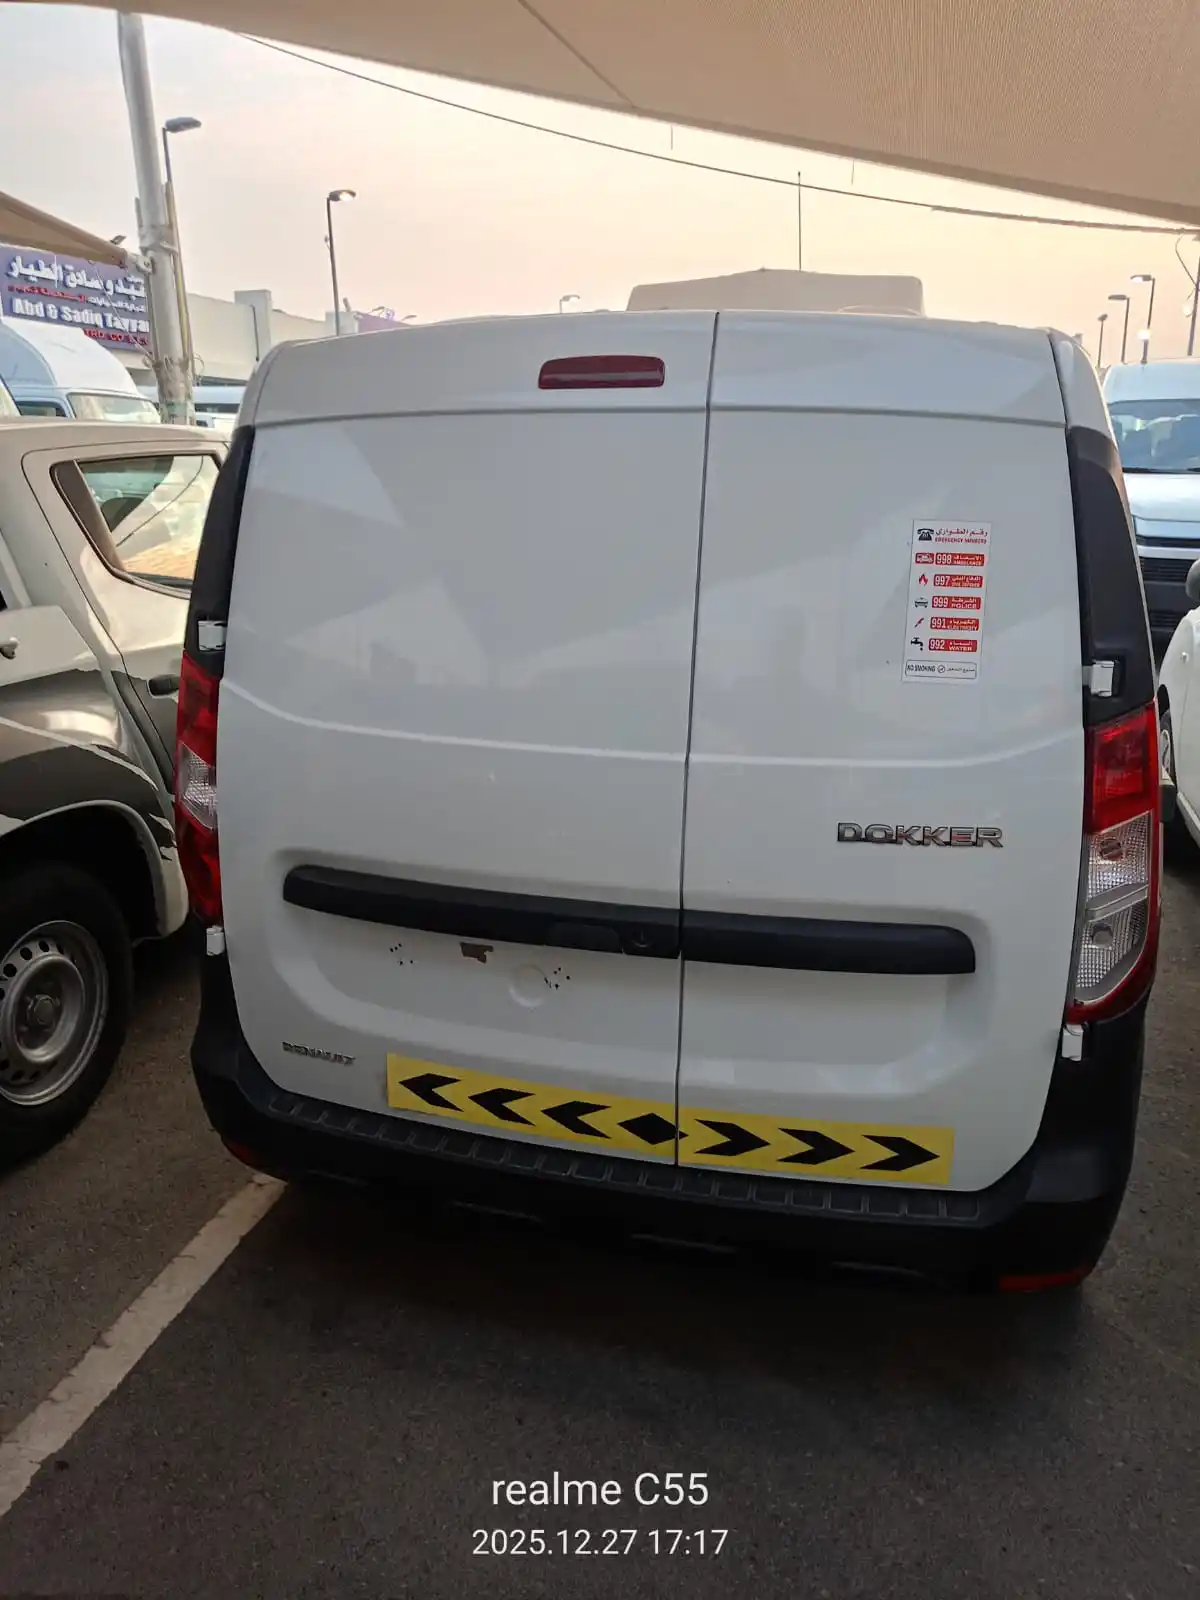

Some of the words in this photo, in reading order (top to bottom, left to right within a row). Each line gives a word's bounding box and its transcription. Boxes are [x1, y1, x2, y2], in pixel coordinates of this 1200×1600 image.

[12, 298, 45, 317] Abd
[60, 306, 104, 328] Sadiq
[936, 553, 952, 564] 998
[935, 575, 950, 586] 997
[932, 596, 949, 607] 999
[931, 618, 947, 629] 991
[929, 639, 945, 650] 992
[907, 664, 914, 672] NO
[914, 664, 936, 673] SMOKING
[837, 822, 1003, 848] DOKKER
